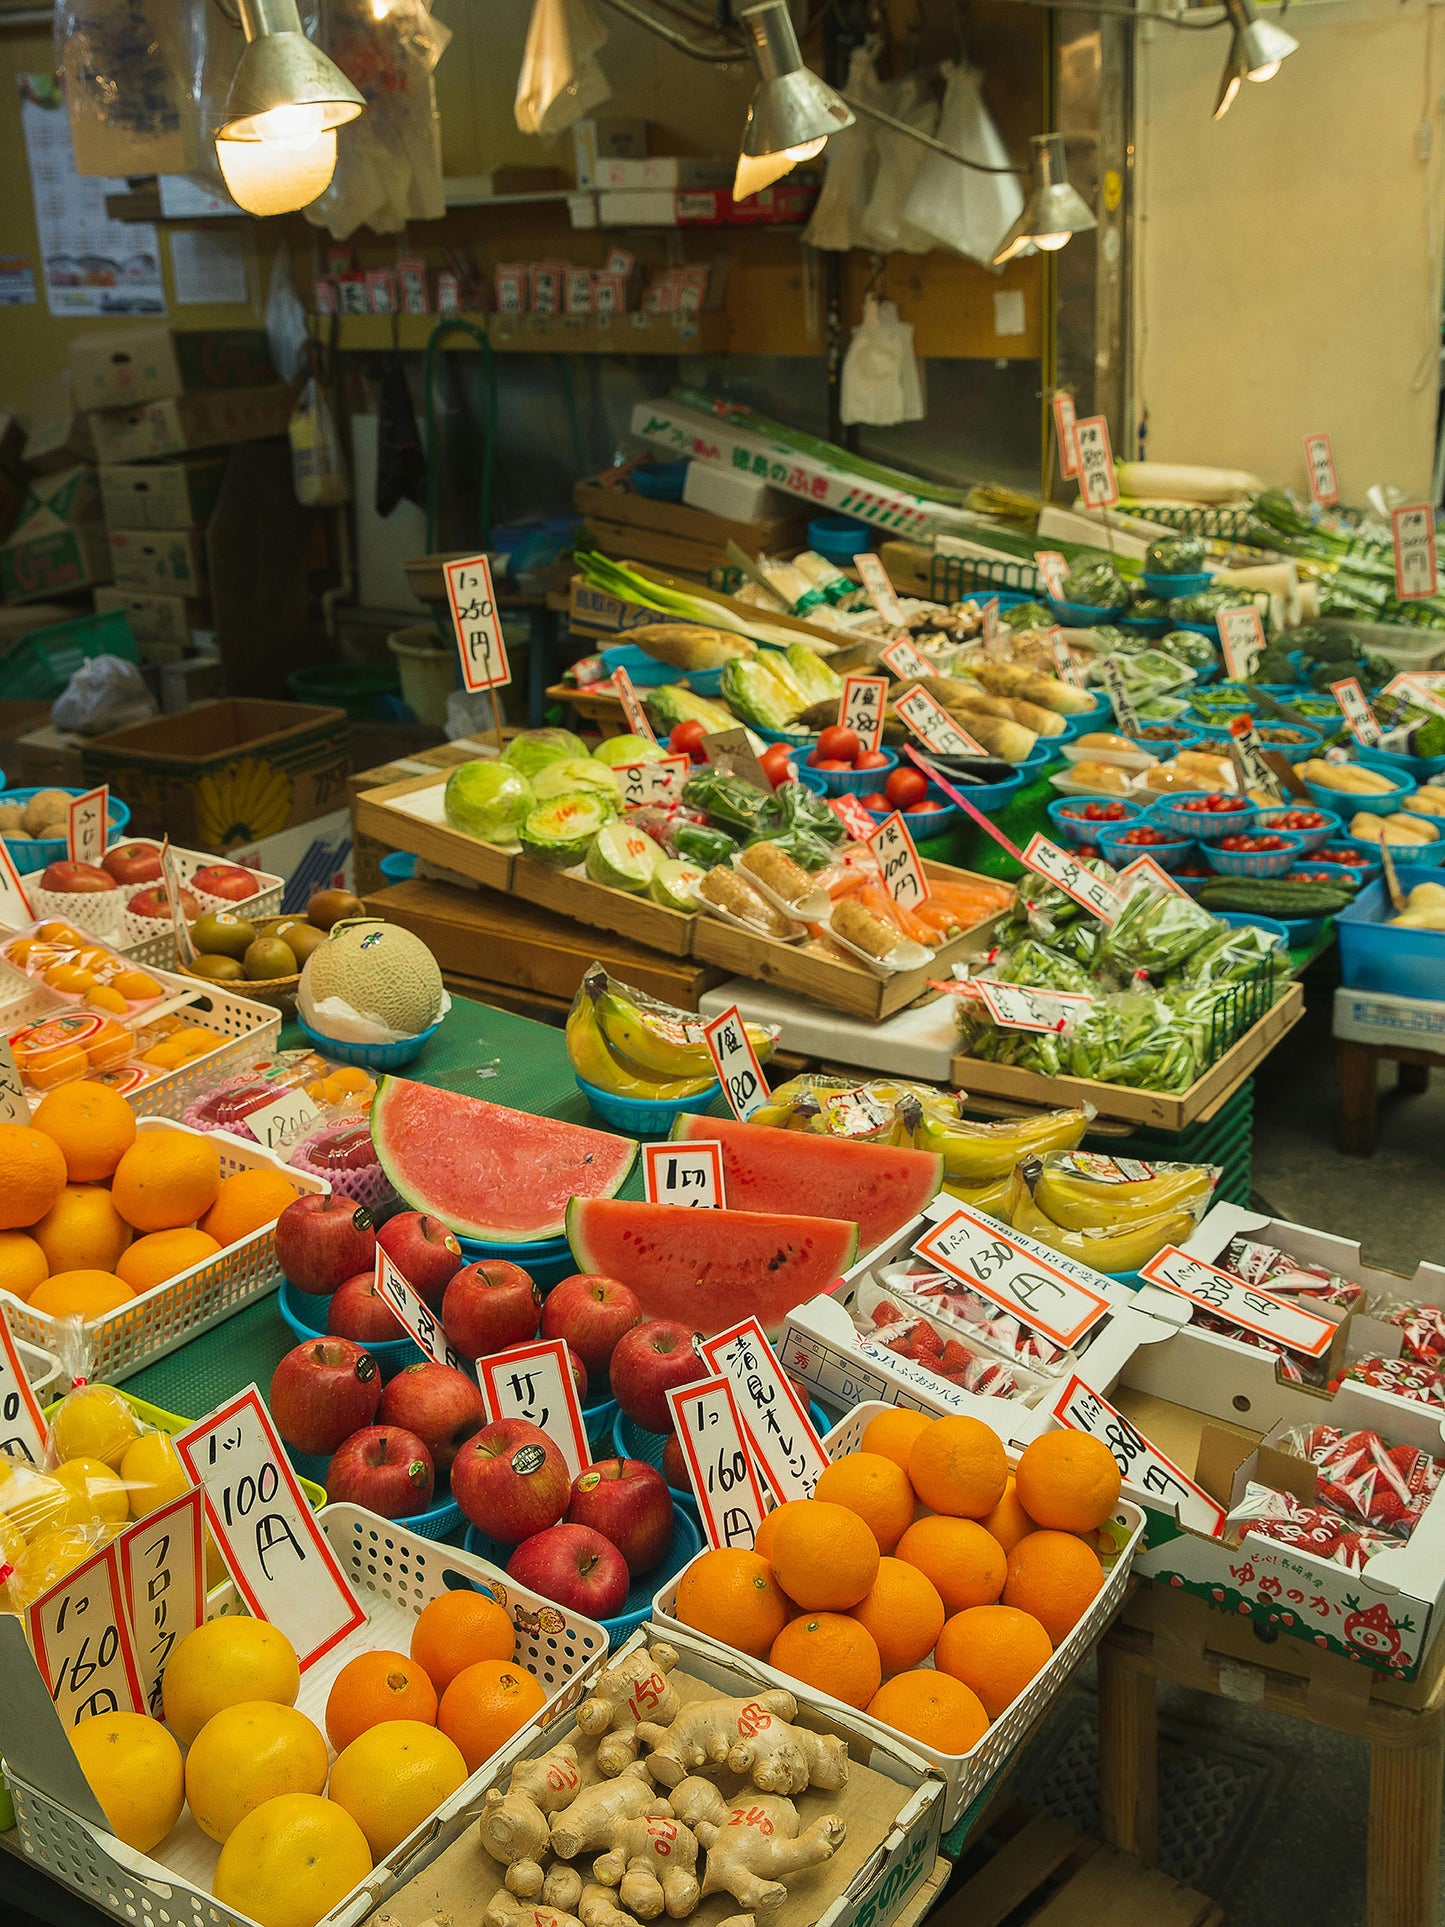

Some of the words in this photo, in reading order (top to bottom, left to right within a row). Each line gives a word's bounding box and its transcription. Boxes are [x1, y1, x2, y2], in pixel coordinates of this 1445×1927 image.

[1089, 472, 1109, 491] 円
[457, 598, 494, 620] 250
[470, 630, 490, 662] 円
[846, 712, 880, 732] 280
[920, 711, 946, 736] 250
[625, 767, 643, 806] 130
[884, 851, 907, 882] 100
[894, 873, 918, 902] 円
[726, 1071, 758, 1115] 180
[970, 1241, 1014, 1280] 630
[1008, 1272, 1066, 1312] 円
[1193, 1276, 1234, 1307] 330
[1243, 1292, 1280, 1316] 円
[794, 1350, 810, 1370] 秀
[841, 1379, 865, 1404] DX
[877, 1355, 897, 1370] JA
[896, 1364, 964, 1406] ふくおか八女
[1105, 1414, 1147, 1477] 580
[708, 1447, 747, 1493] 160
[1143, 1464, 1189, 1498] 円
[223, 1462, 279, 1527] 100
[255, 1513, 307, 1581] 円
[723, 1507, 755, 1552] 円
[1229, 1562, 1342, 1617] ゆめのか
[1280, 1558, 1325, 1590] 長崎県産
[53, 1625, 119, 1701] 160
[74, 1688, 119, 1726] 円
[629, 1672, 665, 1721] 150
[728, 1806, 774, 1836] 240
